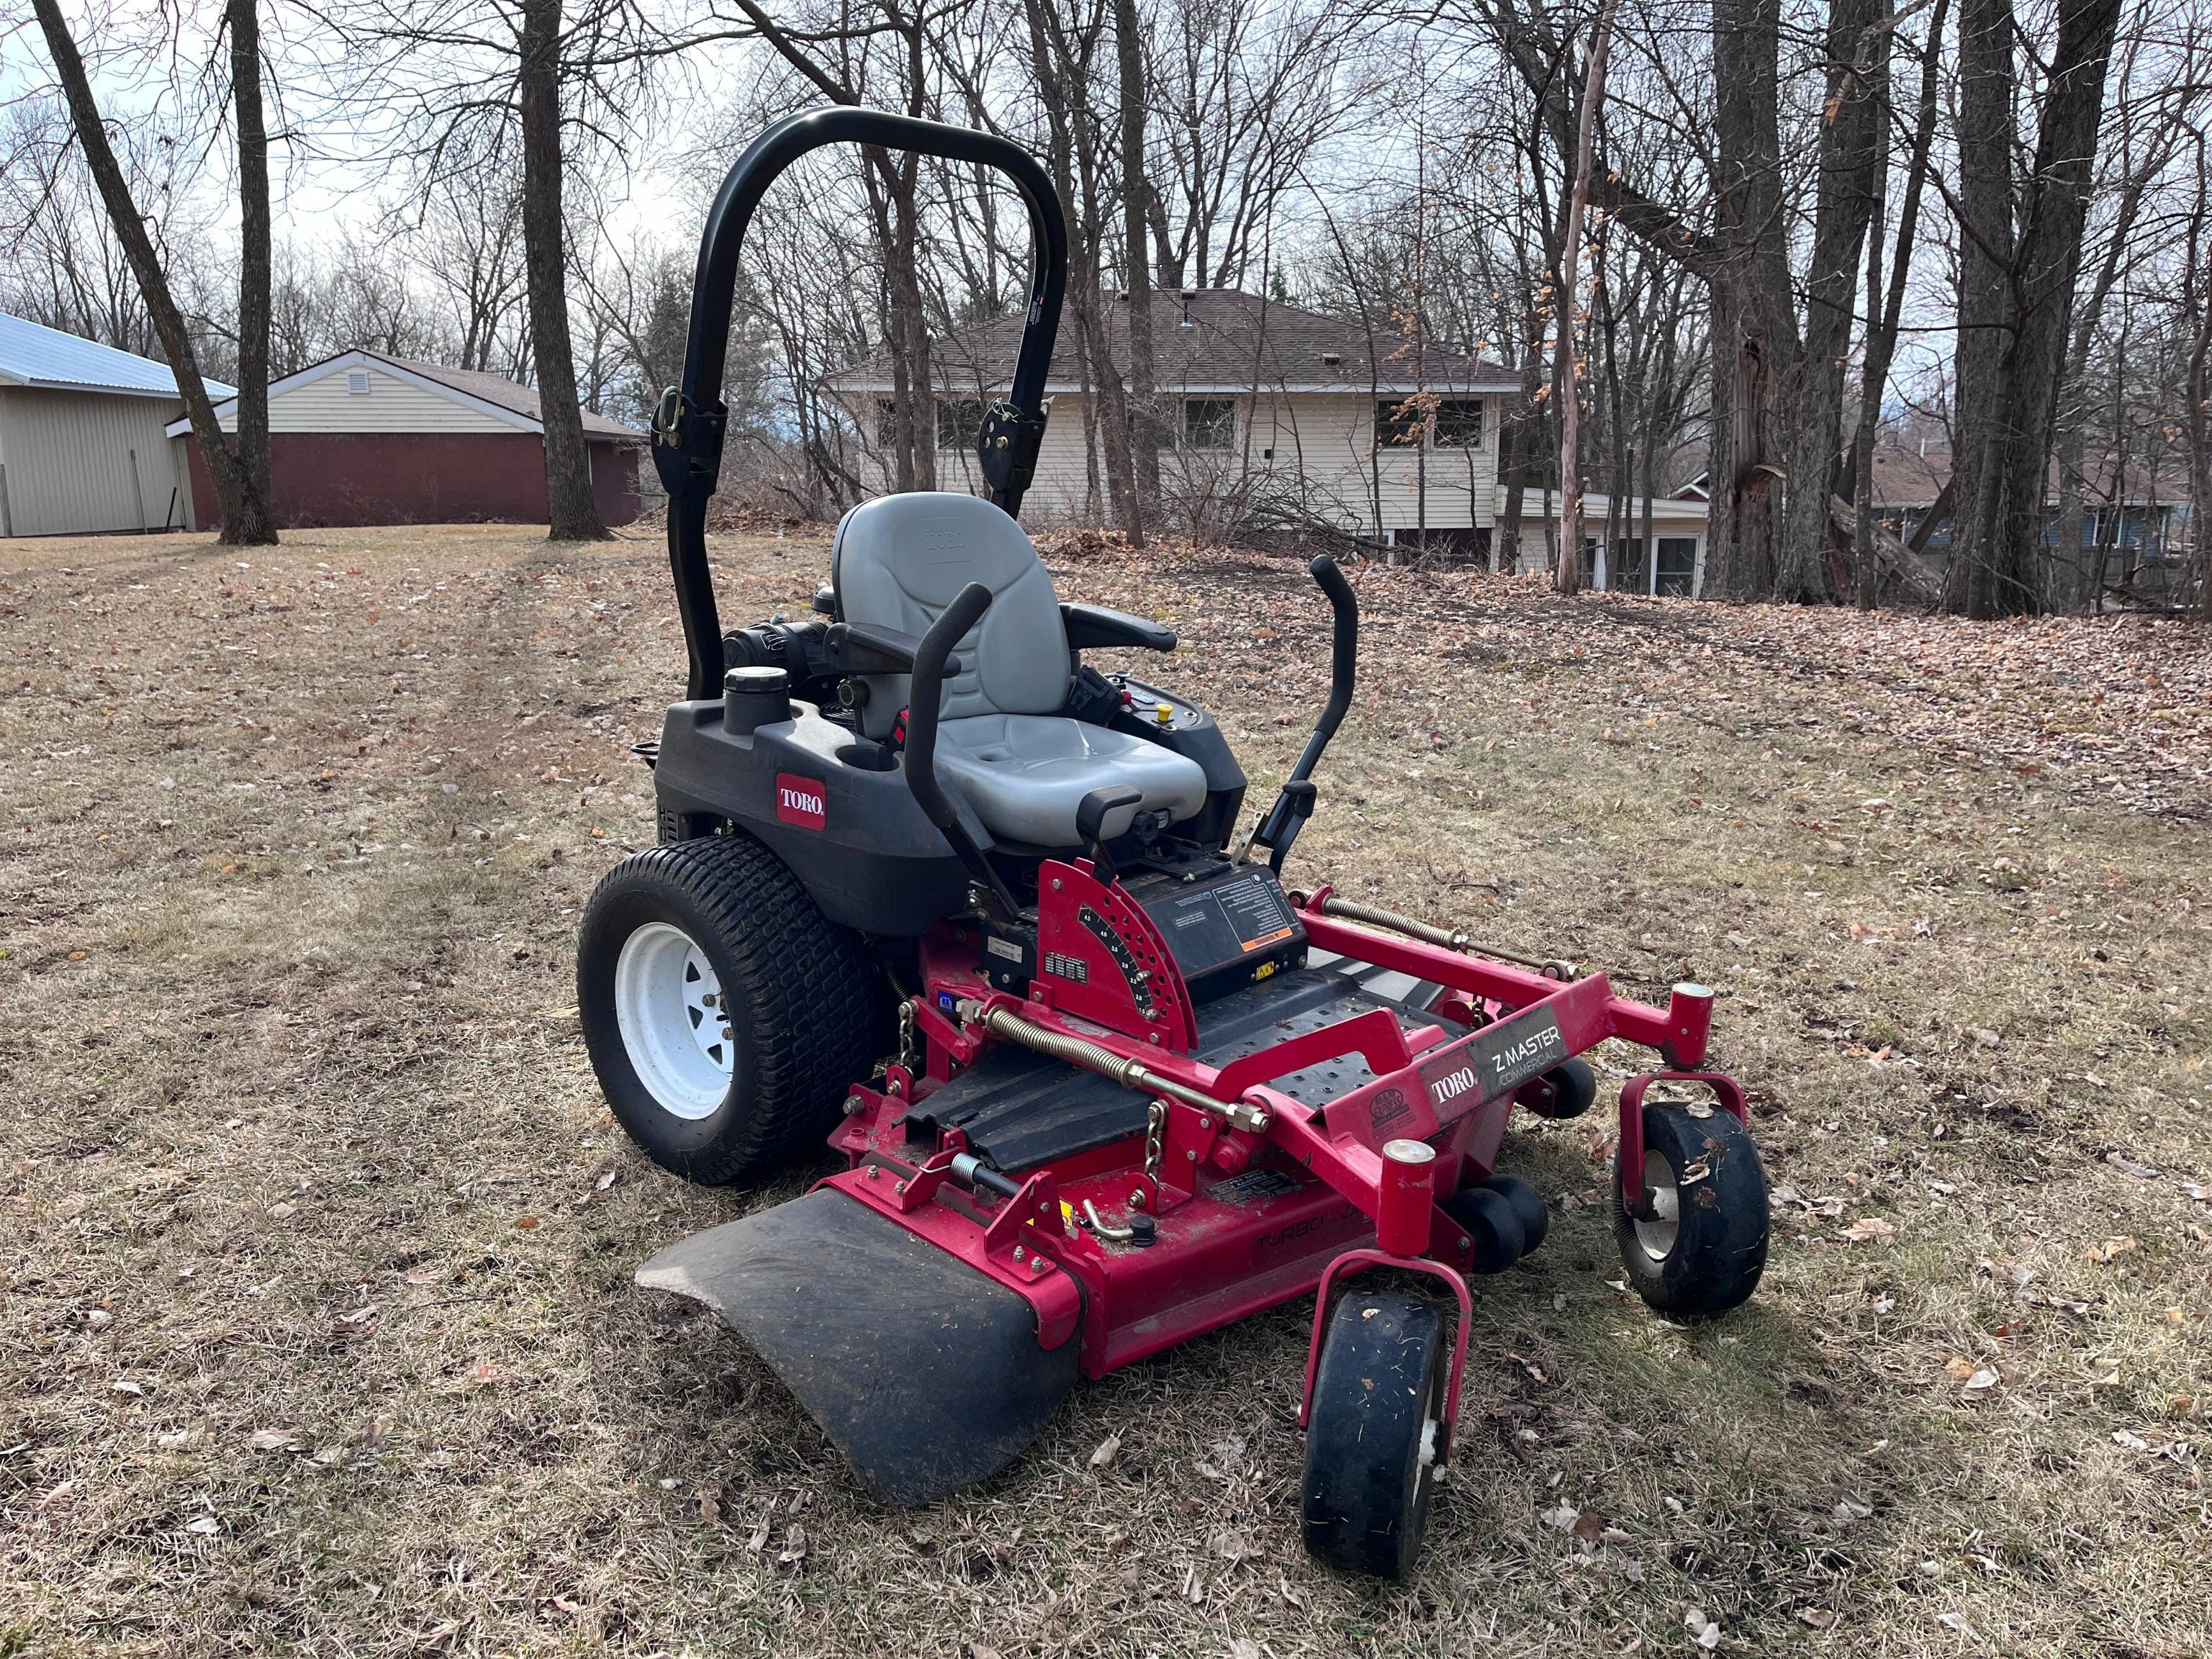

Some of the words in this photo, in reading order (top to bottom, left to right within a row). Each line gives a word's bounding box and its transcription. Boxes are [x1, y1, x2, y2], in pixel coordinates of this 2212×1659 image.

[924, 531, 967, 551] TORO
[1491, 1054, 1506, 1073] Z
[1505, 1026, 1562, 1067] MASTER
[1499, 1050, 1558, 1087] COMMERCIAL
[1257, 1216, 1324, 1249] TURBO
